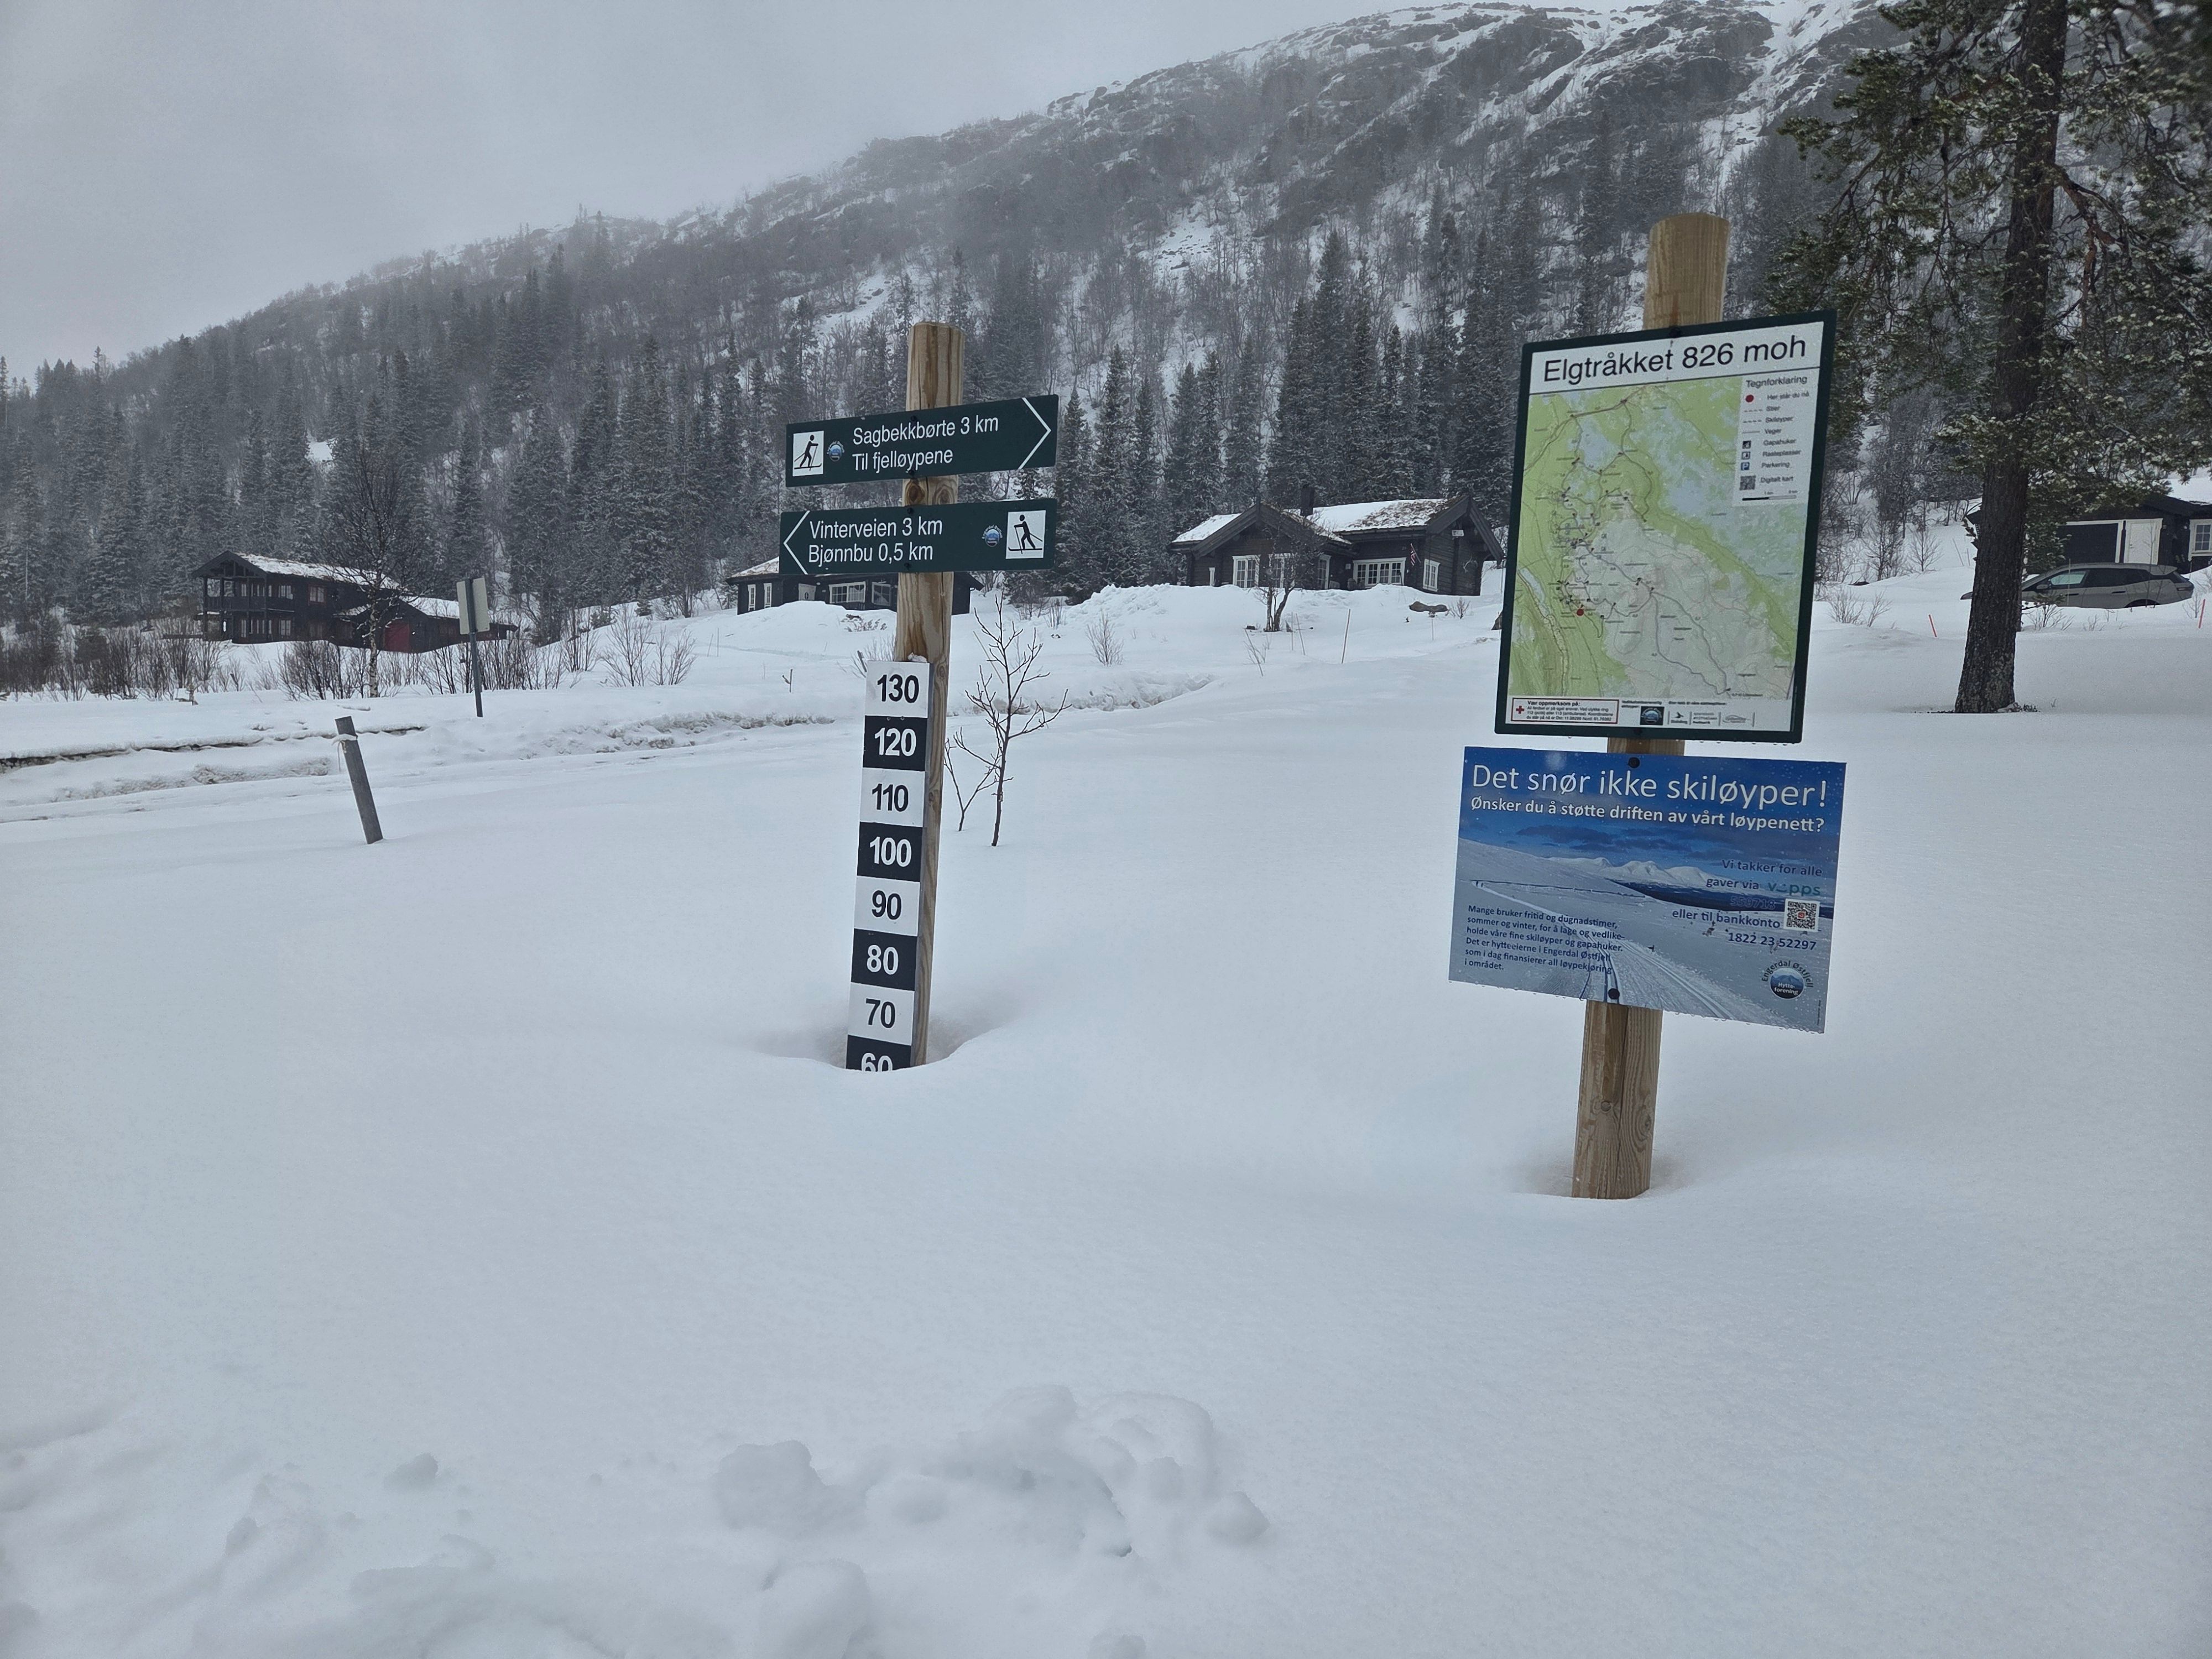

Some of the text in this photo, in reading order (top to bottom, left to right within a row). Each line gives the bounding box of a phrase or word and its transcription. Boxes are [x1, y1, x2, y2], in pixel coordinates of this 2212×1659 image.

[1543, 335, 1806, 385] Elgtråkket 826 moh
[1745, 376, 1808, 389] Tegnforklaring
[853, 415, 999, 448] Sagbekkbørte 3 km
[852, 449, 953, 474] Til fjelløypene
[810, 516, 942, 539] Vinterveien 3 km
[808, 541, 933, 567] Bjønnbu 0,5 km
[877, 674, 920, 704] 130
[874, 727, 916, 757] 120
[872, 782, 909, 811] 110
[1472, 765, 1827, 810] Det snør ikke skiløyper!
[1471, 795, 1824, 832] Ønsker du å støtte driften av vårt løypenett?
[869, 836, 912, 867] 100
[1721, 859, 1823, 877] Vi takker for alle
[1706, 878, 1739, 888] gaver
[1742, 879, 1759, 890] via
[871, 889, 902, 921] 90
[1468, 905, 1618, 930] Mange bruker fritid og dugnadstimer,
[1467, 917, 1499, 926] sommer
[1501, 921, 1511, 929] og
[1512, 921, 1537, 931] vinter,
[1560, 926, 1577, 936] lage
[1579, 930, 1590, 938] og
[1672, 909, 1781, 929] eller til bankkonto
[1466, 937, 1480, 946] Det
[1491, 940, 1537, 952] hytteeierne
[1543, 947, 1579, 957] Engerdal
[1580, 951, 1610, 962] Østfjell
[1467, 926, 1489, 936] holde
[1509, 931, 1524, 940] fine
[1526, 933, 1563, 946] skiløyper
[1565, 939, 1575, 947] og
[1577, 941, 1624, 952] gapahuker.
[1727, 932, 1817, 951] 1822 23 52297
[866, 943, 899, 975] 80
[1469, 961, 1504, 970] området.
[1488, 951, 1502, 961] dag
[1504, 953, 1547, 964] finansierer
[1560, 959, 1612, 975] løypekjøring
[1761, 960, 1814, 988] Engerdal Østfjell
[1774, 987, 1799, 995] forening
[865, 998, 896, 1029] 70
[860, 1052, 893, 1072] 60
